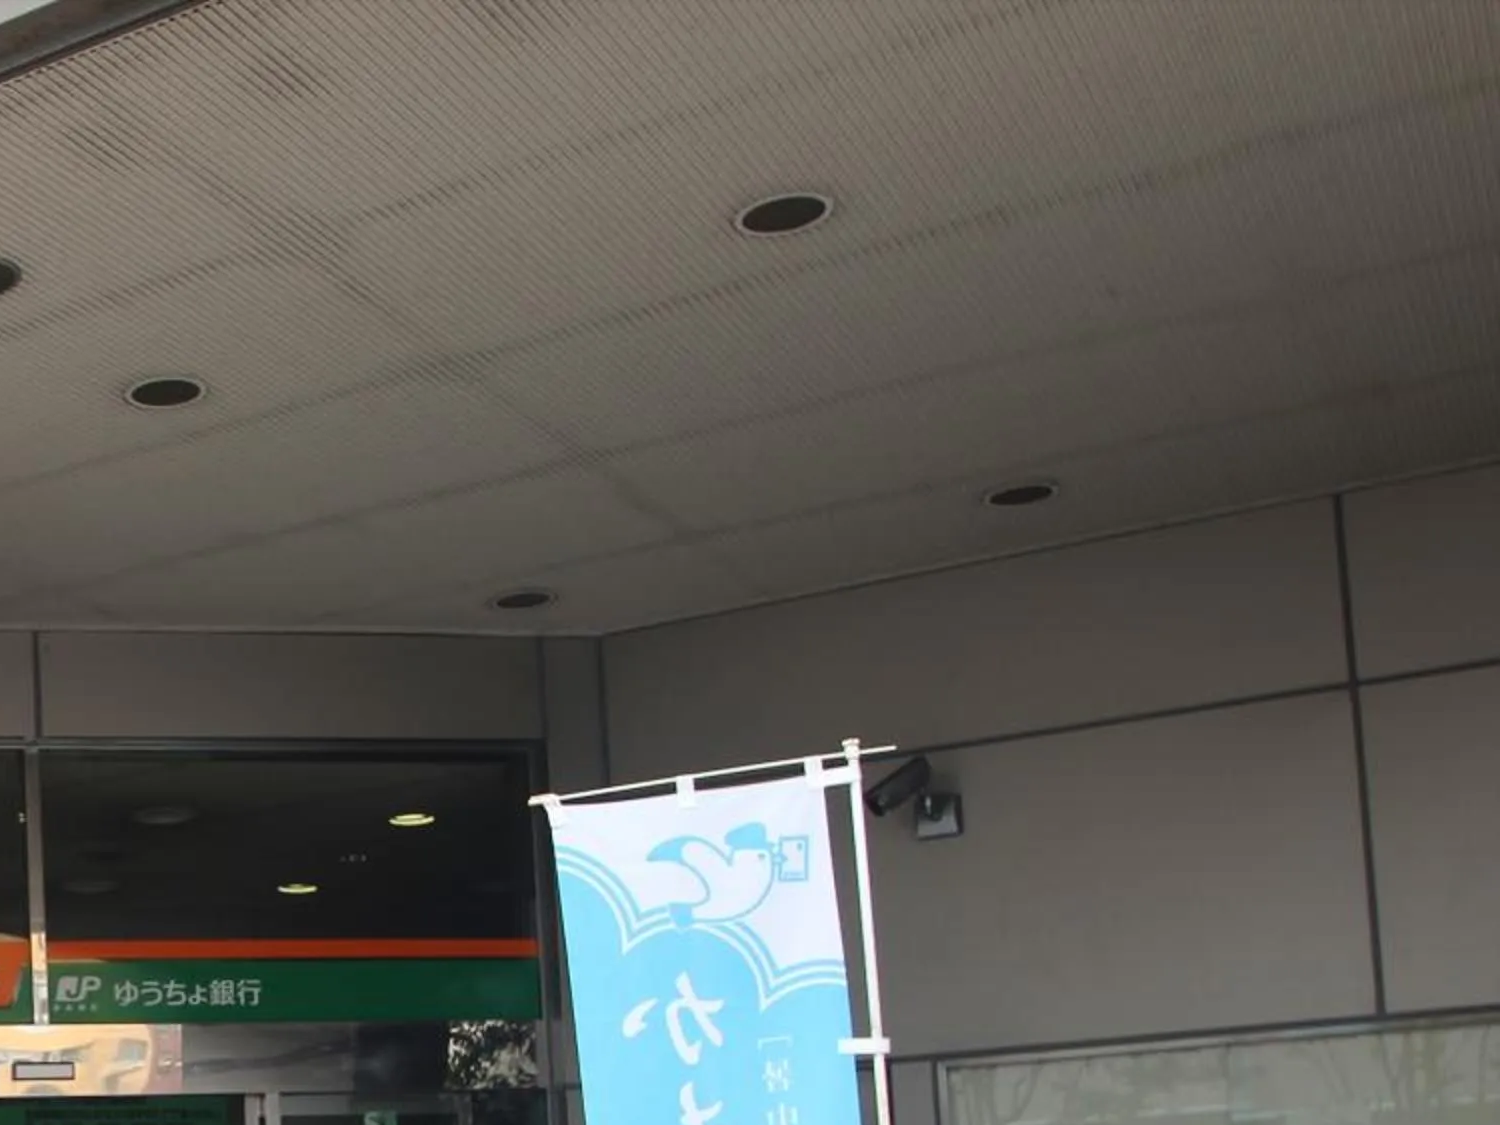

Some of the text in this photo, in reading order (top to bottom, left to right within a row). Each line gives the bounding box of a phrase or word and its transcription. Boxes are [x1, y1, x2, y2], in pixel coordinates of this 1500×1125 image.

[113, 976, 262, 1007] ゆうちょ銀行
